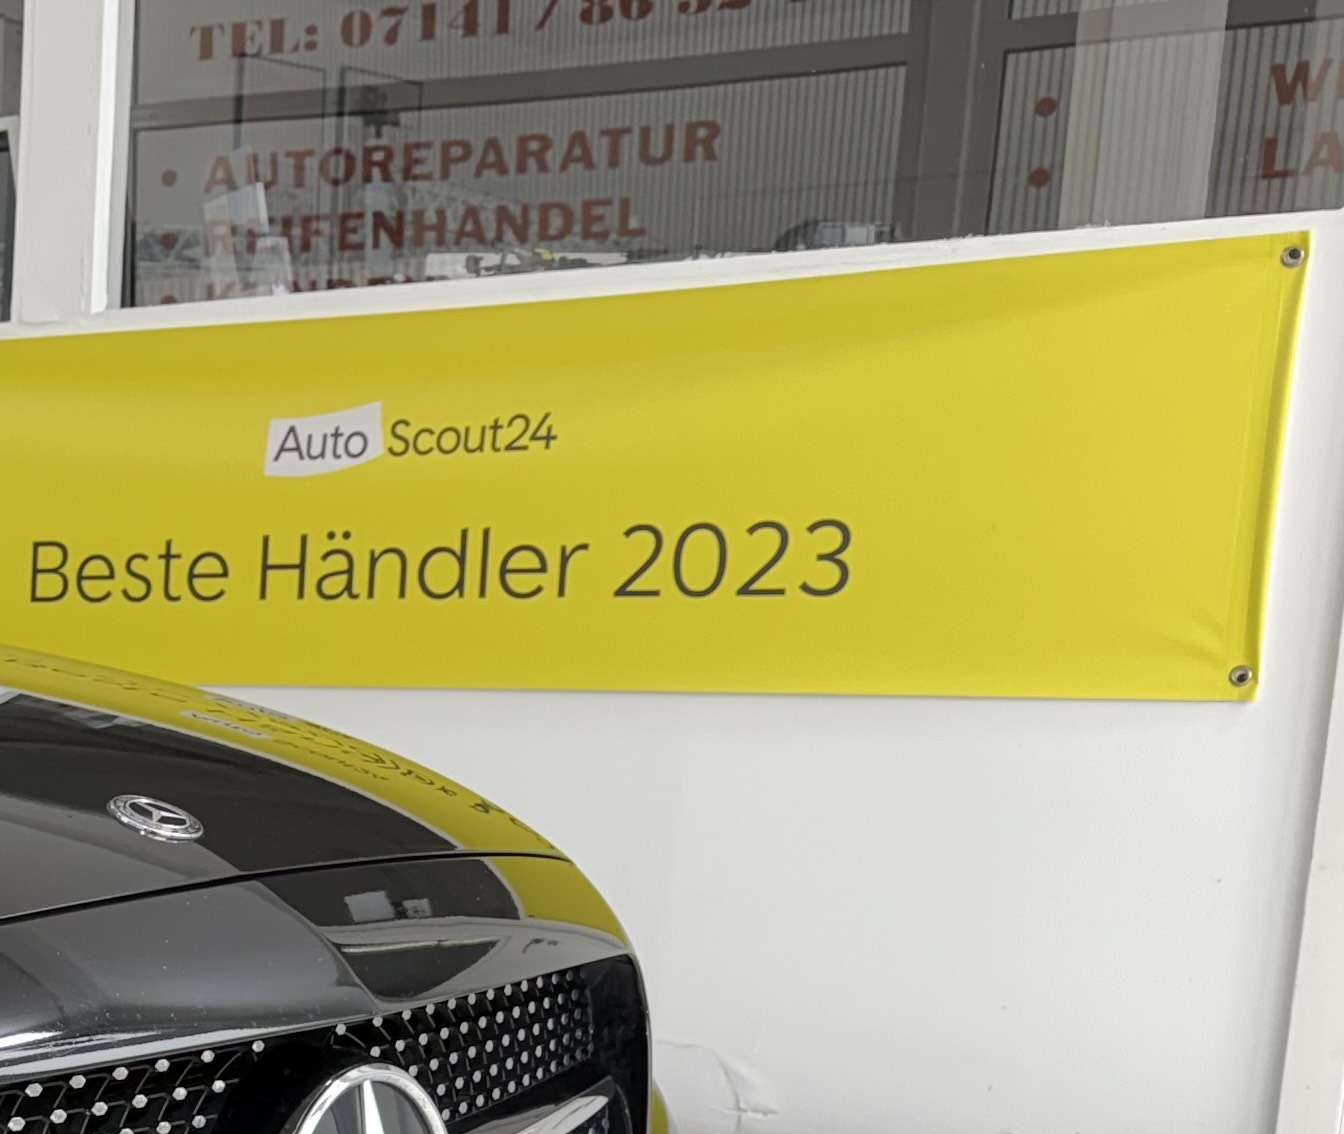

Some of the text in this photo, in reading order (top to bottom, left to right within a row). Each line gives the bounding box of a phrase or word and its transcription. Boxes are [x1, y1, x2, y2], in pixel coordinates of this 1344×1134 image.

[189, 18, 318, 61] TEL:
[339, 0, 511, 48] 07141
[204, 119, 722, 193] AUTOREPARATUR
[273, 411, 559, 463] Auto Scout24
[28, 518, 853, 604] Beste Händler 2023
